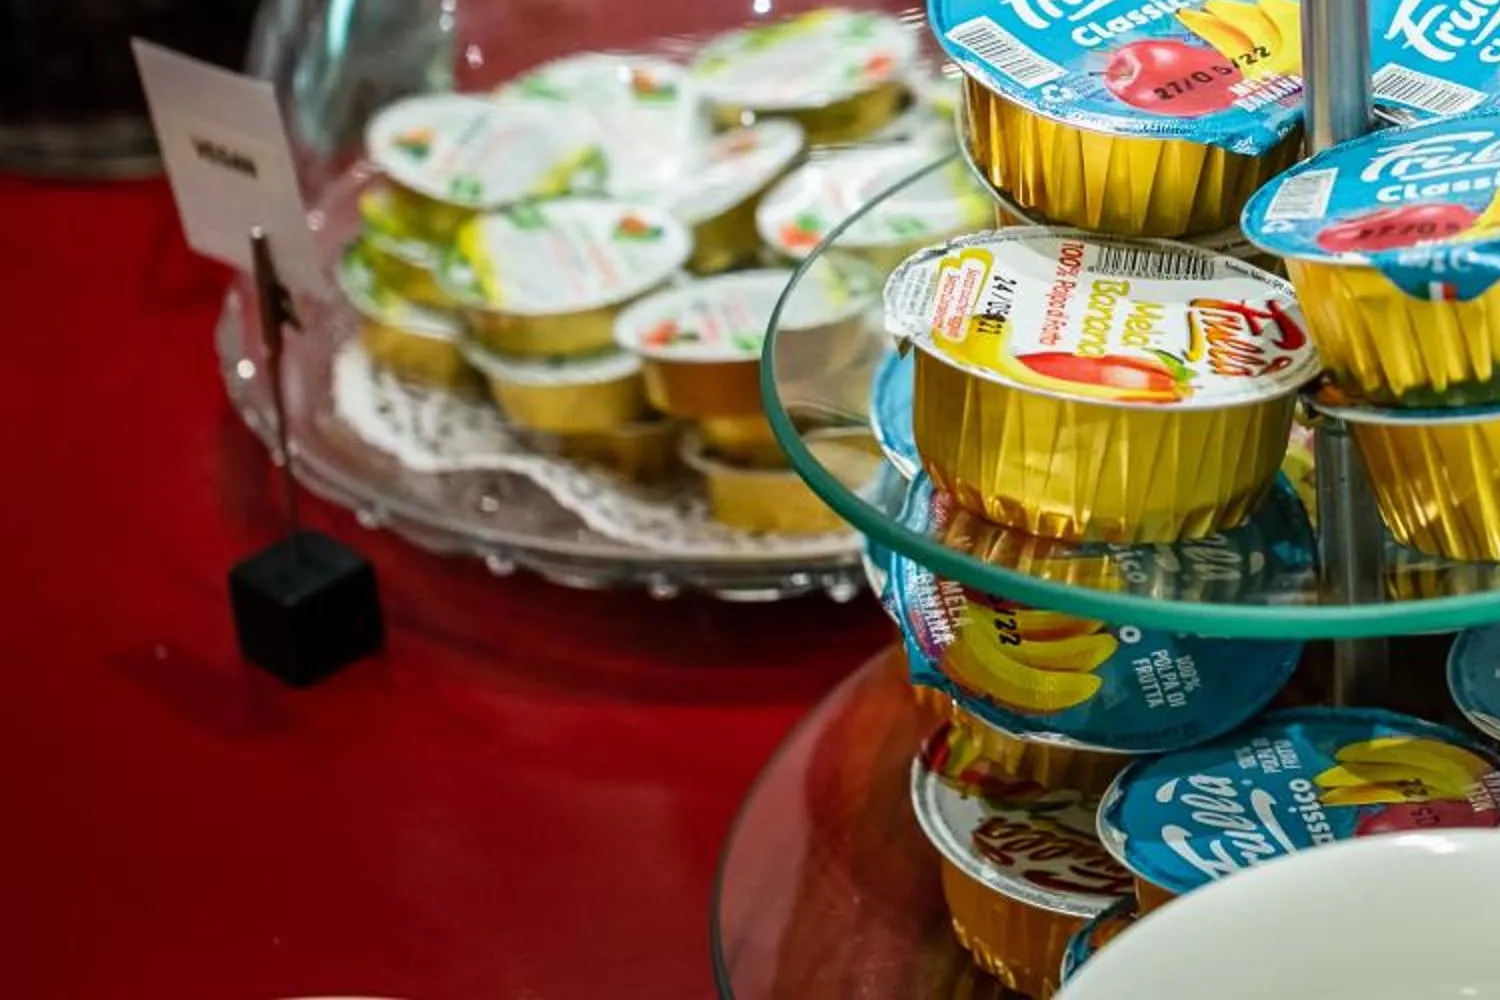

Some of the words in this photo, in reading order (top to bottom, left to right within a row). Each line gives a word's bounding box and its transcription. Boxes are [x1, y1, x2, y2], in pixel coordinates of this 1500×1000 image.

[1056, 240, 1085, 277] 100%
[1075, 279, 1131, 357] Banana
[1121, 299, 1166, 348] Mela
[938, 580, 975, 629] MELA
[1131, 657, 1165, 709] FRUTTA
[1151, 649, 1180, 692] POLPA
[1288, 778, 1336, 846] assico
